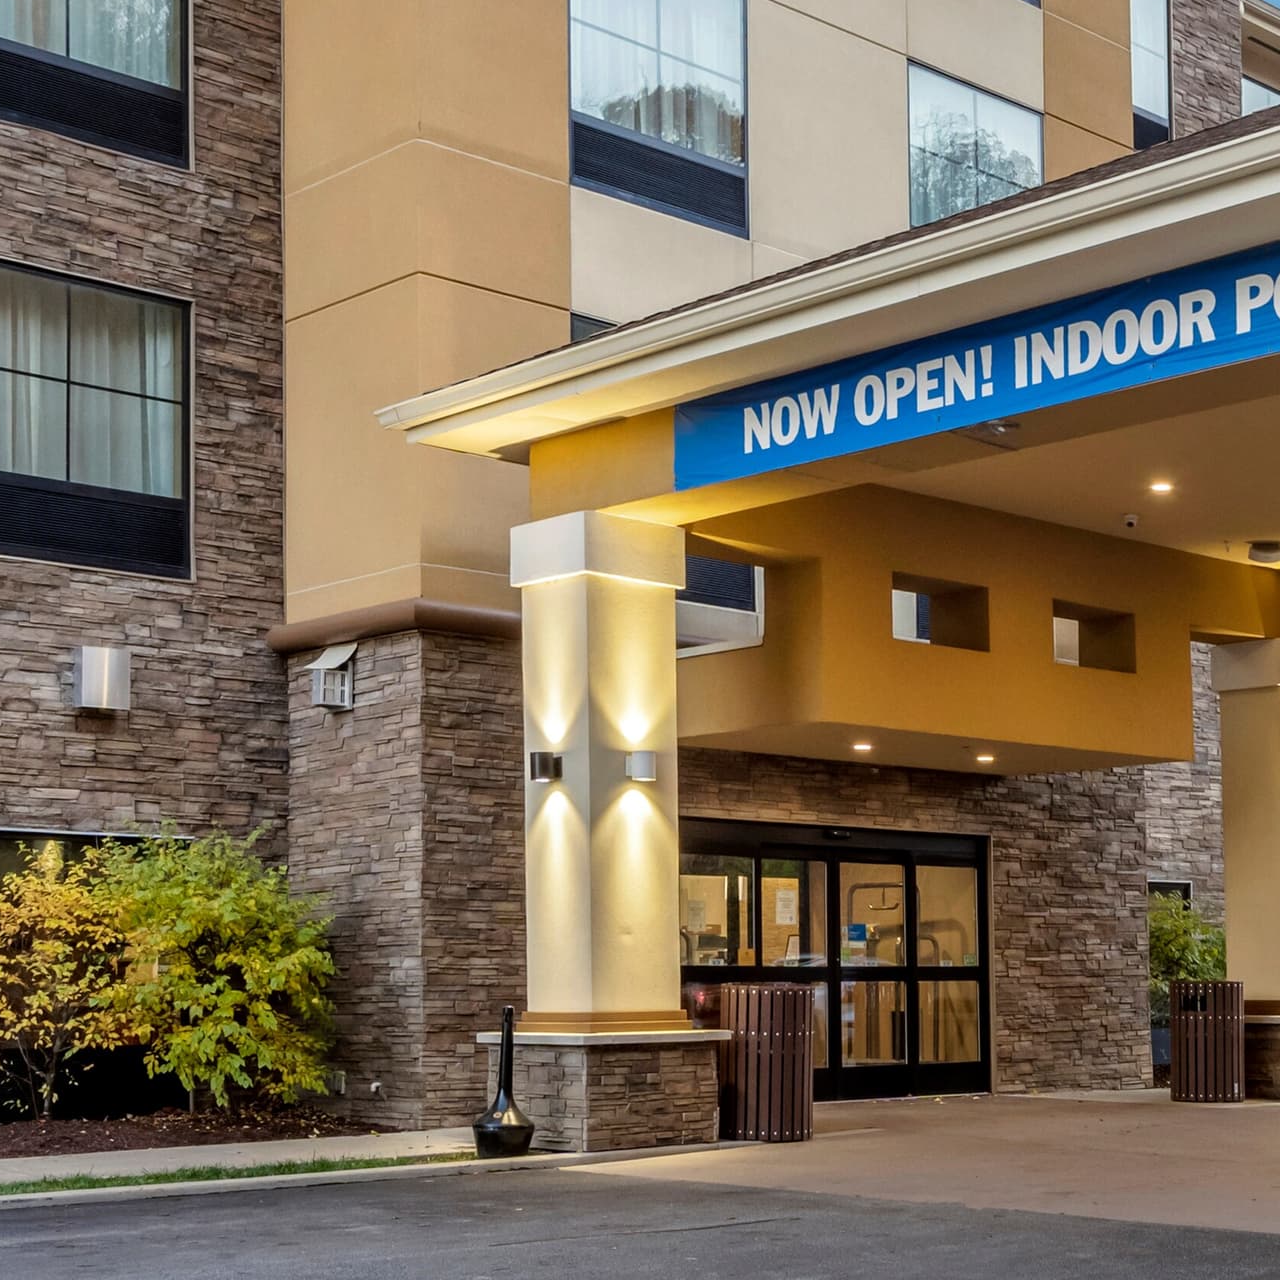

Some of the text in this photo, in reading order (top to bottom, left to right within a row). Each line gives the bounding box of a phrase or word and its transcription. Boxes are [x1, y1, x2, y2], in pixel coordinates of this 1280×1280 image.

[743, 383, 840, 455] NOW
[853, 344, 994, 427] OPEN!
[1013, 288, 1217, 390] INDOOR
